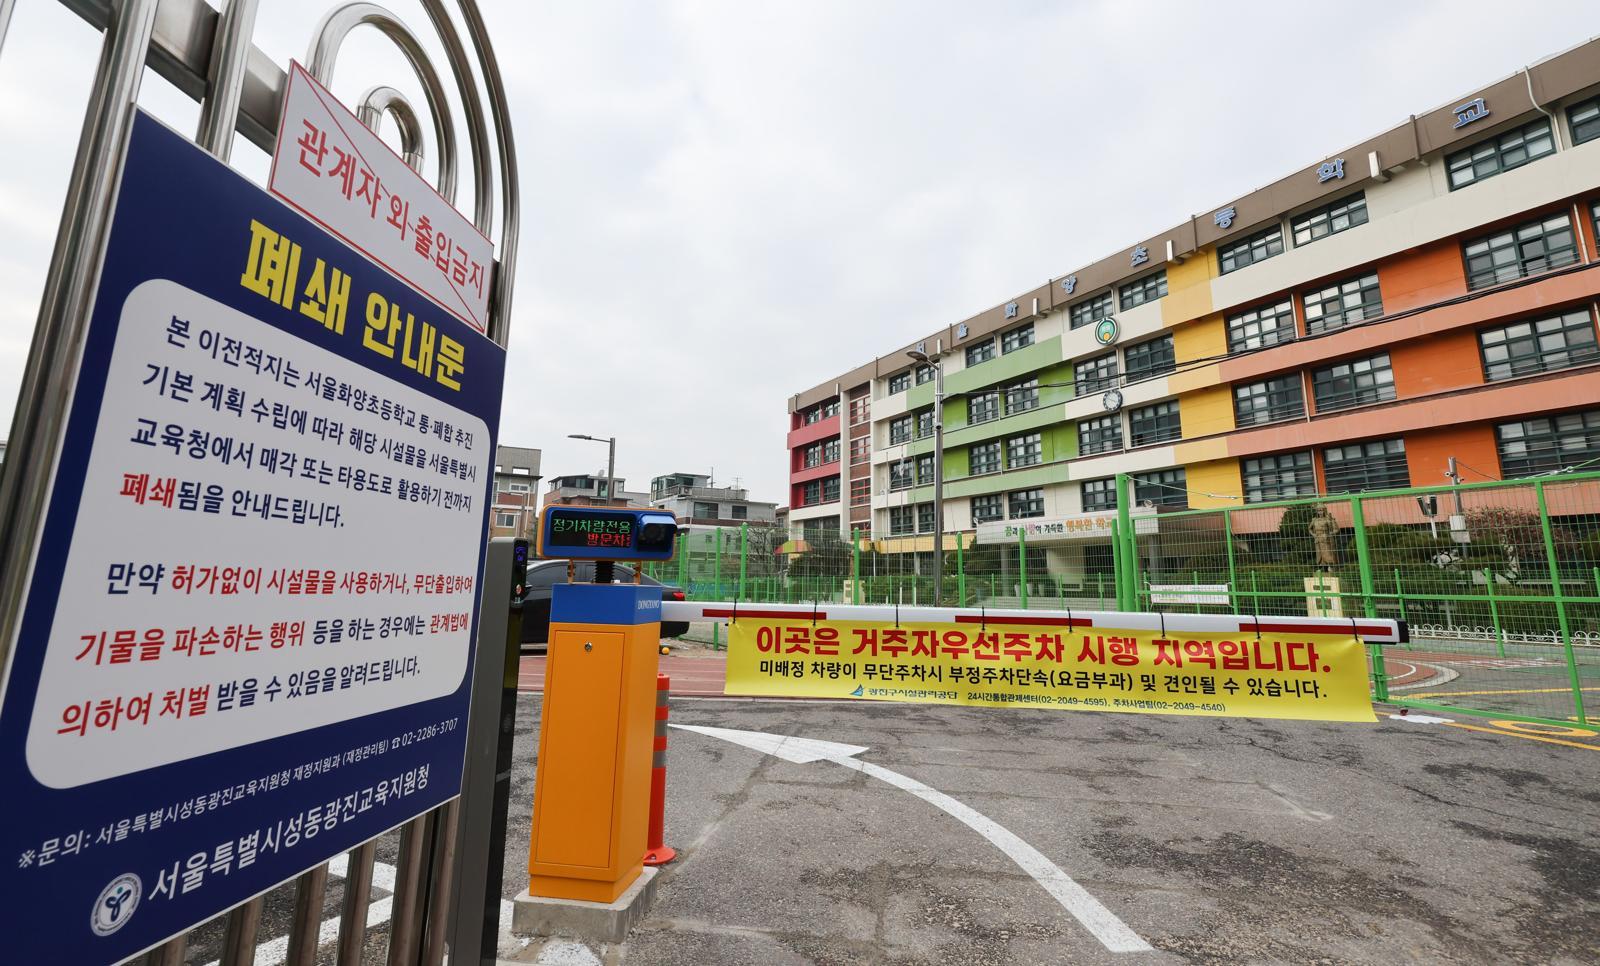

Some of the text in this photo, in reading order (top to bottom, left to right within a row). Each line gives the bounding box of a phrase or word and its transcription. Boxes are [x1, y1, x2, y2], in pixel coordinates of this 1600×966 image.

[297, 118, 484, 299] 관계자 외 출입금지
[240, 218, 465, 392] 폐쇄 안내문
[142, 363, 477, 483] 기본 계획 수립에 따라 해당 시설물을 서울특별시
[166, 315, 191, 349] 본
[199, 329, 300, 388] 이전적지는
[305, 371, 416, 428] 서울화양초등학교
[455, 429, 473, 450] 추진
[120, 473, 344, 528] 폐쇄됨을 안내드립니다.
[130, 418, 472, 513] 교육청에서 매각 또는 타용도로 활용하기 전까지
[553, 518, 631, 534] 정기차량전용
[107, 562, 473, 595] 만약 허가없이 시설물을 사용하거나, 무단출입하여
[75, 612, 469, 666] 기물을 파손하는 행위 등을 하는 경우에는 관계법에
[756, 626, 1331, 673] 이곳은 거주자우선주차 시행 지역입니다.
[760, 660, 1328, 699] 미배정 차량이 무단주차시 부정주차단속(요금부과) 및 견인될 수 있습니다.
[57, 655, 421, 737] 의하여 처벌 받을 수 있음을 알려드립니다.
[96, 769, 291, 845] 서울특별시성동광진교육지원청
[292, 754, 341, 782] 재정지원과
[342, 739, 389, 766] (재정관리팀)
[148, 763, 430, 901] 서울특별시성동광진교육지원청
